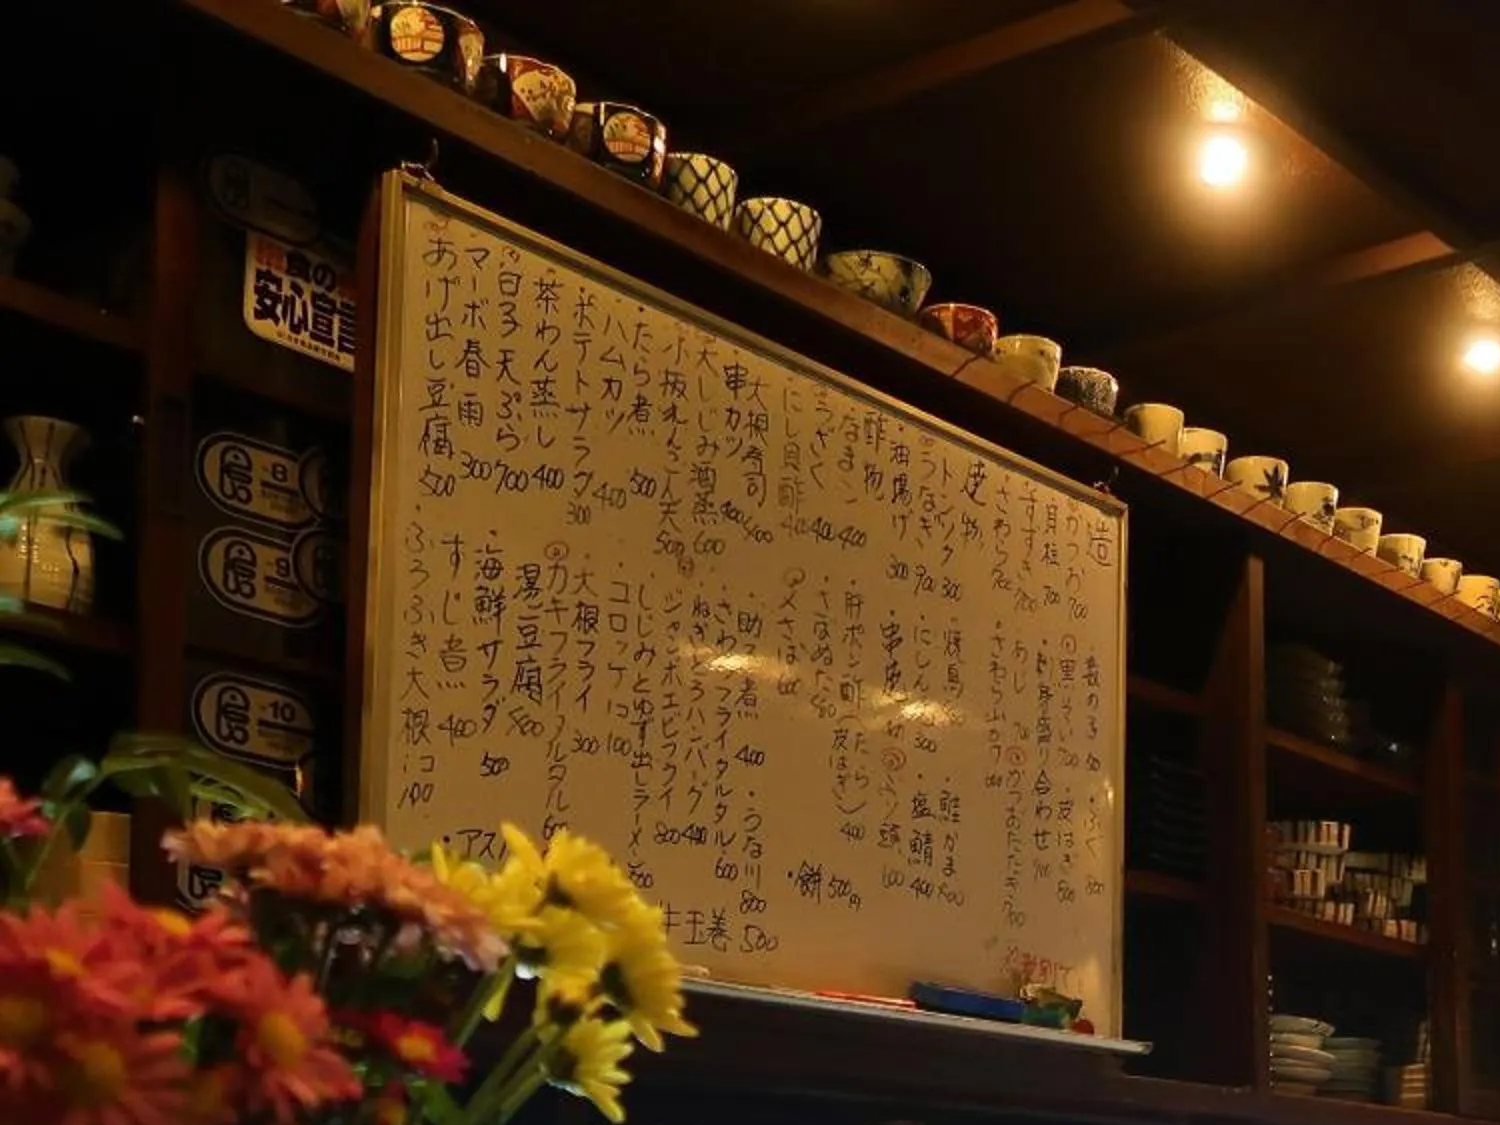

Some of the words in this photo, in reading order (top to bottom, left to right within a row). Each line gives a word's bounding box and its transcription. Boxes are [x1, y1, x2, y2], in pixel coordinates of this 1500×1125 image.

[418, 238, 458, 460] あげ出し豆腐
[454, 246, 491, 427] マーボ春雨
[496, 270, 522, 453] 白子天ぷら
[529, 277, 565, 448] 茶わん蒸し
[599, 313, 629, 434] ハムカツ
[627, 320, 656, 437] たら煮
[722, 362, 748, 459] 串カツ
[459, 452, 491, 481] 300
[493, 460, 529, 494] 700
[532, 464, 565, 491] 400
[566, 501, 592, 525] 300
[692, 530, 726, 556] 600
[992, 485, 1012, 568] さわら
[400, 520, 435, 746] ふろふき大根
[472, 542, 507, 734] 海鮮サラダ
[571, 572, 599, 714] 大根フライ
[480, 751, 510, 778] 500
[606, 730, 633, 757] 100
[713, 599, 738, 847] さわフライタルタル
[715, 857, 739, 881] 600
[740, 924, 779, 953] 500
